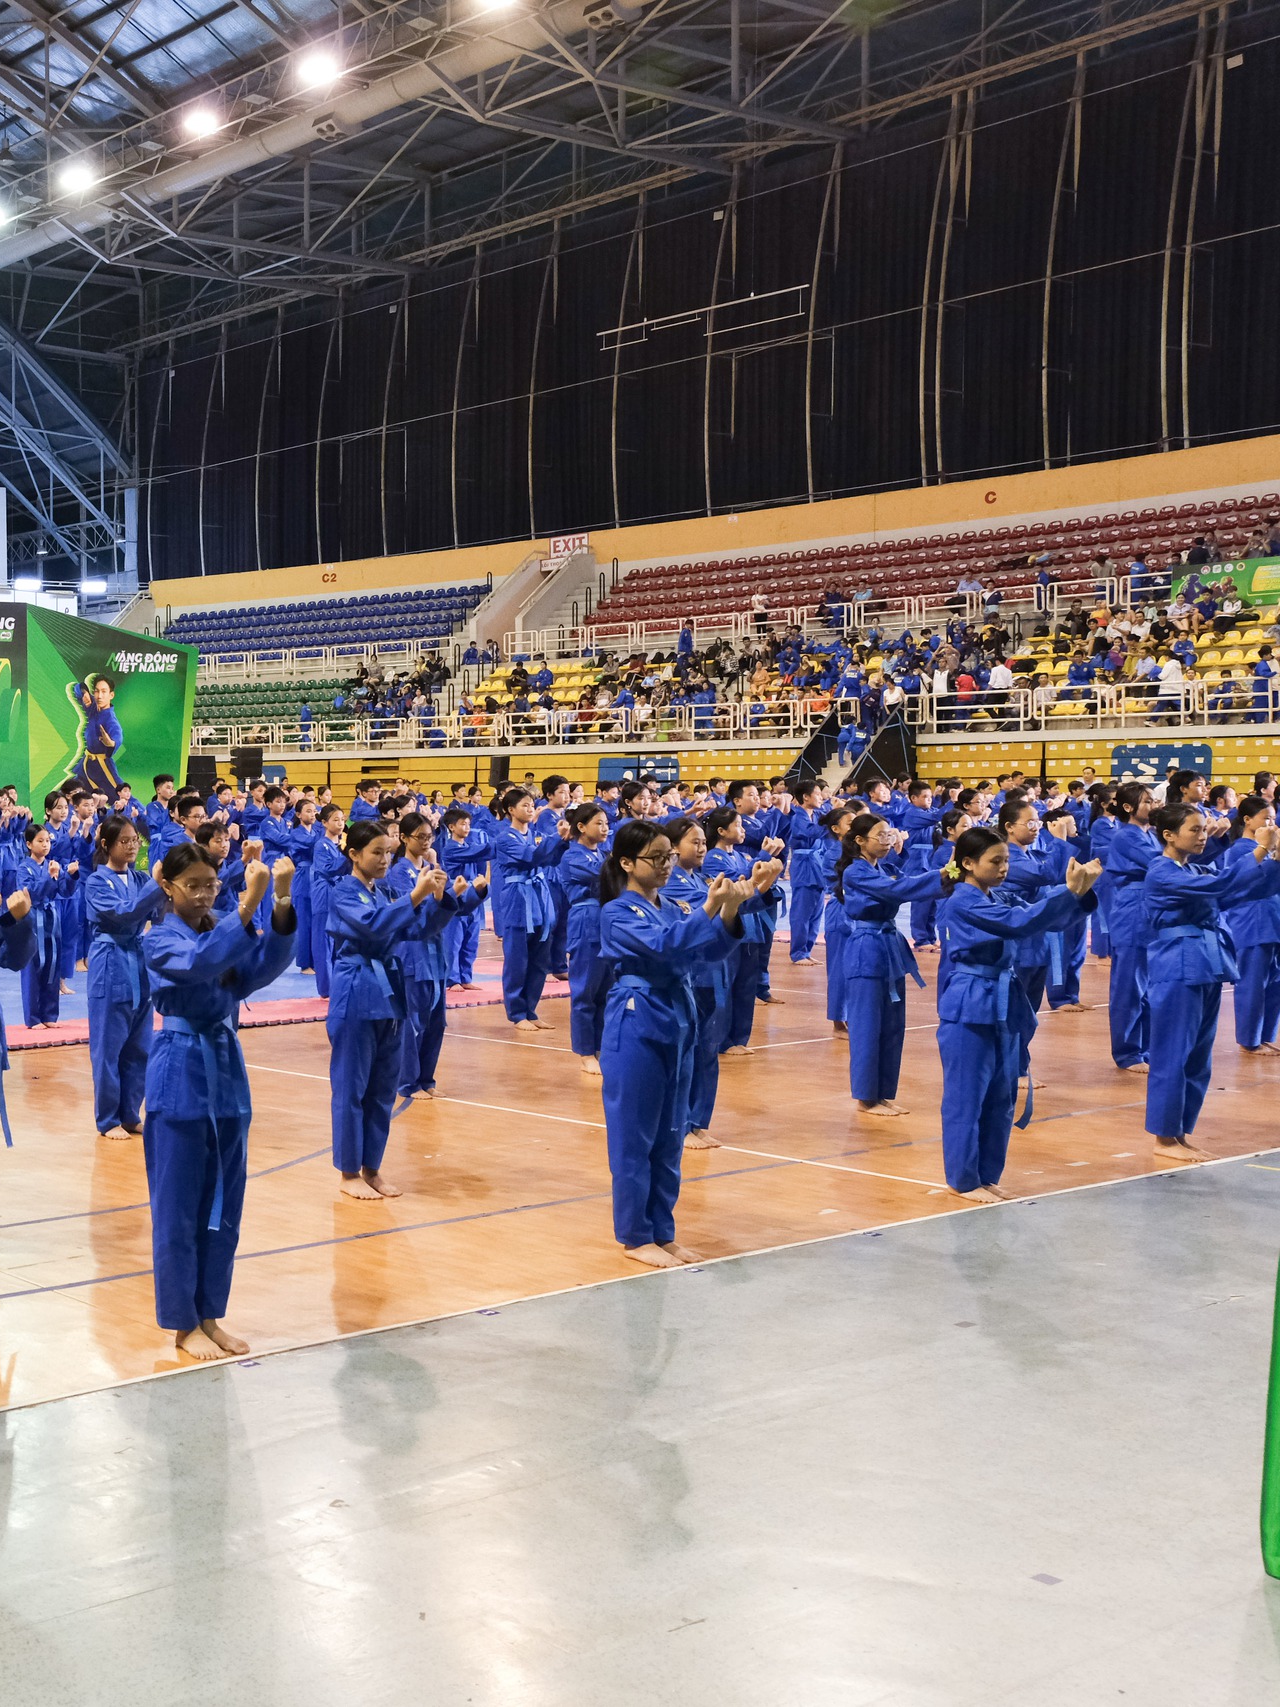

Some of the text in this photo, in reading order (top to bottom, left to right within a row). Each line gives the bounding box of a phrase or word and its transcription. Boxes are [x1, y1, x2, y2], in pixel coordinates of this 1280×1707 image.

[553, 536, 585, 554] EXIT
[322, 573, 337, 583] C2
[106, 650, 144, 667] NĂNG
[111, 660, 137, 673] VIỆT
[138, 663, 166, 673] NAM
